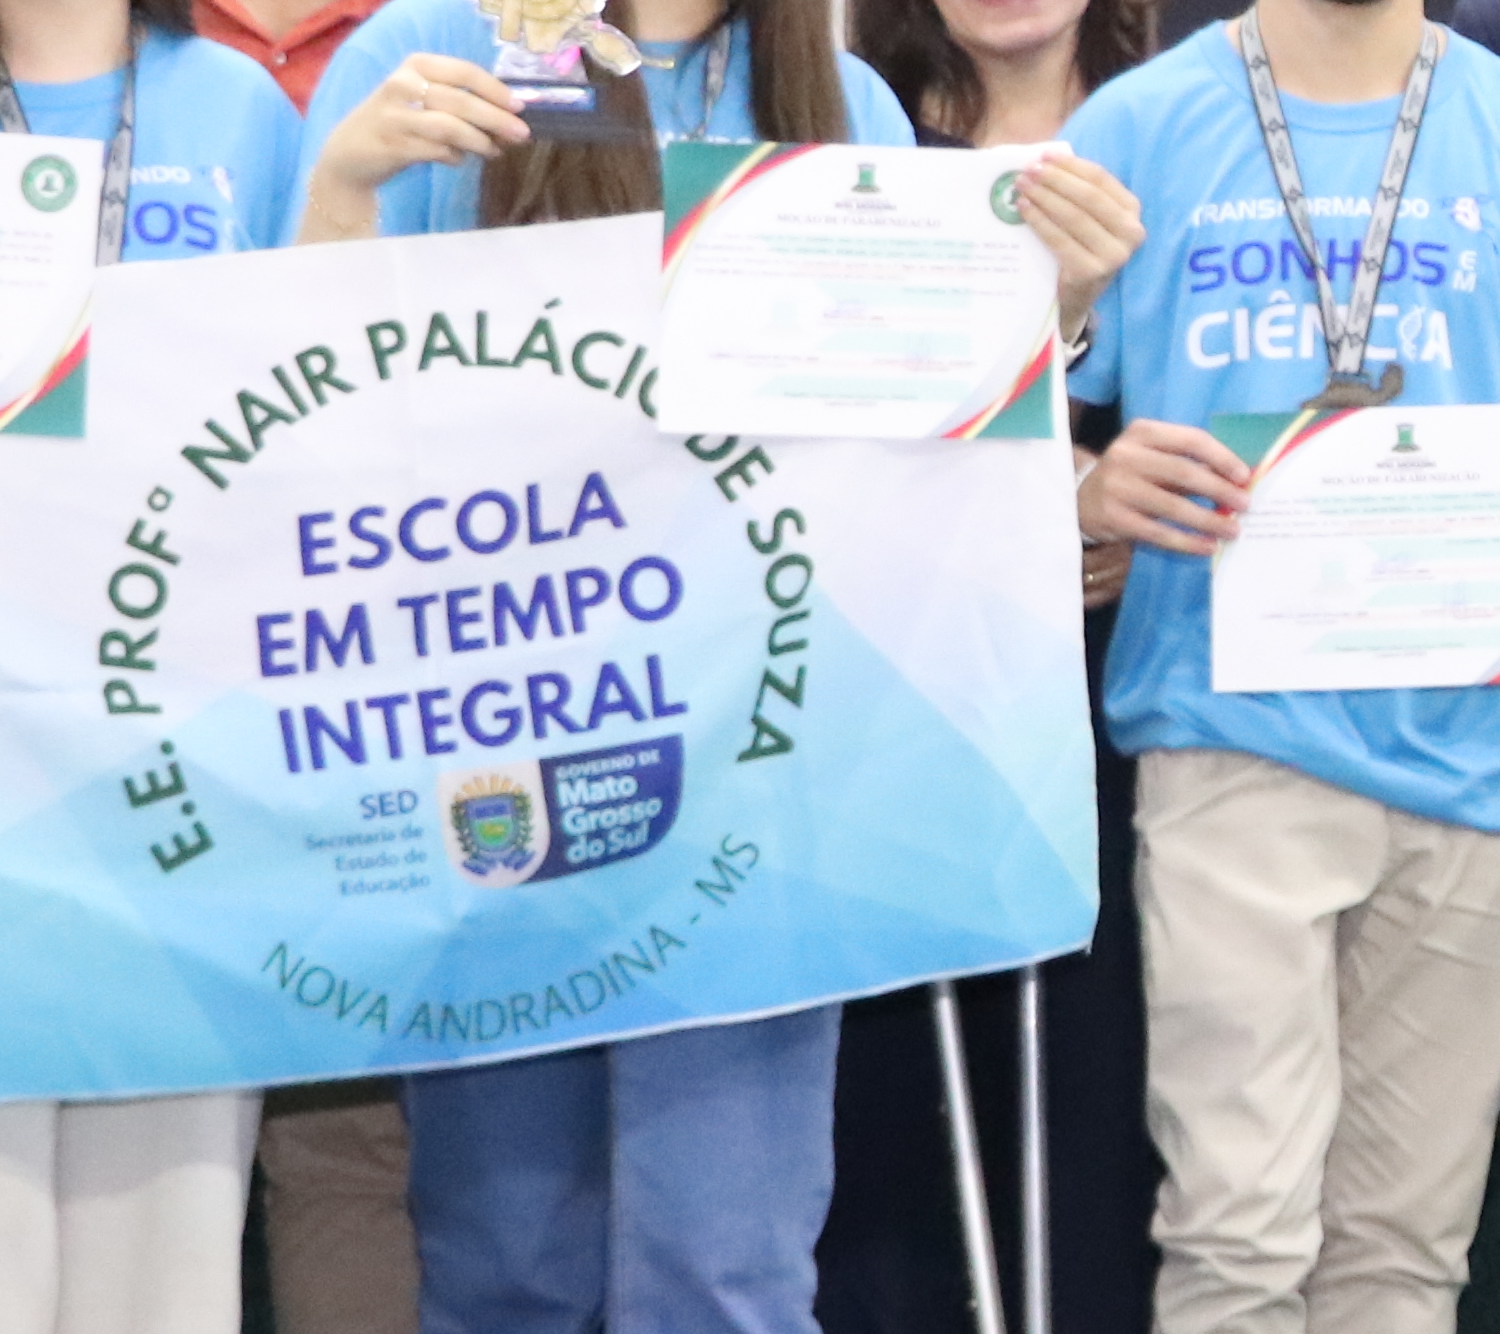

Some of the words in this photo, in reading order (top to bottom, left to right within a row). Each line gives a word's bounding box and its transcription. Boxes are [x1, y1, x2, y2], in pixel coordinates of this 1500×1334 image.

[296, 471, 626, 577] ESCOLA
[123, 738, 216, 876] E.E.
[180, 344, 357, 491] NAIR
[737, 505, 816, 765] SOUZA
[255, 601, 376, 679] EM
[397, 554, 685, 659] TEMPO
[276, 653, 690, 775] INTEGRAL
[638, 748, 662, 766] DE
[359, 788, 419, 822] SED
[557, 774, 638, 808] Mato
[305, 829, 398, 851] Secretaria
[400, 823, 424, 842] de
[562, 797, 663, 837] Grosso
[334, 853, 400, 872] Estado
[403, 848, 427, 865] de
[565, 836, 605, 865] do
[607, 823, 651, 854] Sul
[338, 872, 431, 897] Educação
[261, 940, 391, 1034] NOVA
[401, 923, 688, 1045] ANDRADINA
[695, 831, 762, 910] MS
